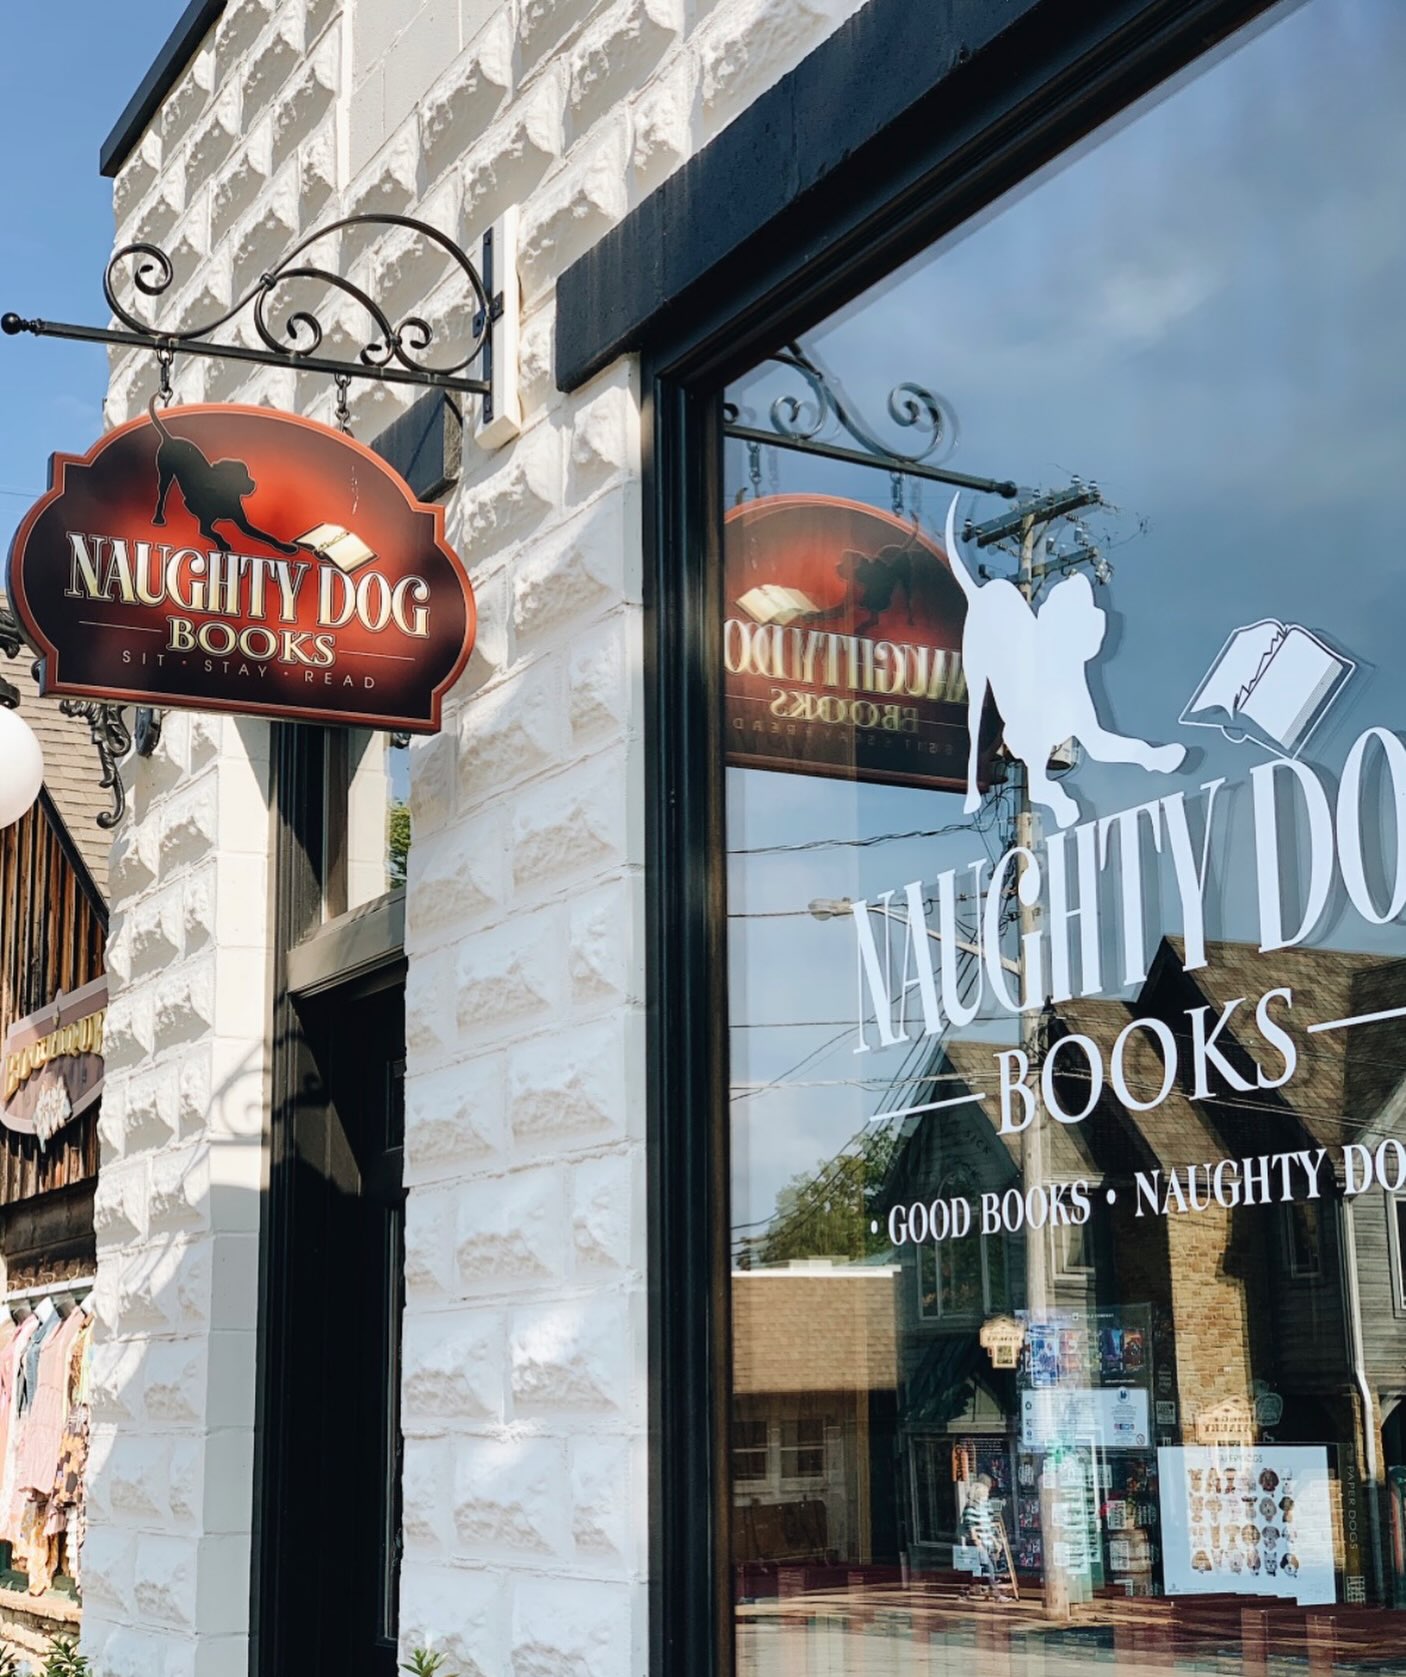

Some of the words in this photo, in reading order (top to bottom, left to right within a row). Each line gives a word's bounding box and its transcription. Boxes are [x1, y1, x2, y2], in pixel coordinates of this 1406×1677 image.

[64, 531, 312, 622] NAUGHTY
[316, 564, 431, 638] DOG
[122, 650, 165, 667] SIT
[203, 659, 267, 678] STAY
[304, 672, 375, 689] READ
[167, 617, 336, 668] BOOKS
[850, 777, 1226, 1054] NAUGHTY
[993, 987, 1298, 1136] BOOKS
[888, 1196, 971, 1246] GOOD
[981, 1179, 1091, 1235] BOOKS
[1134, 1148, 1328, 1217] NAUGHTY
[1347, 1465, 1357, 1506] PAPER
[1348, 1510, 1359, 1550] DOGS
